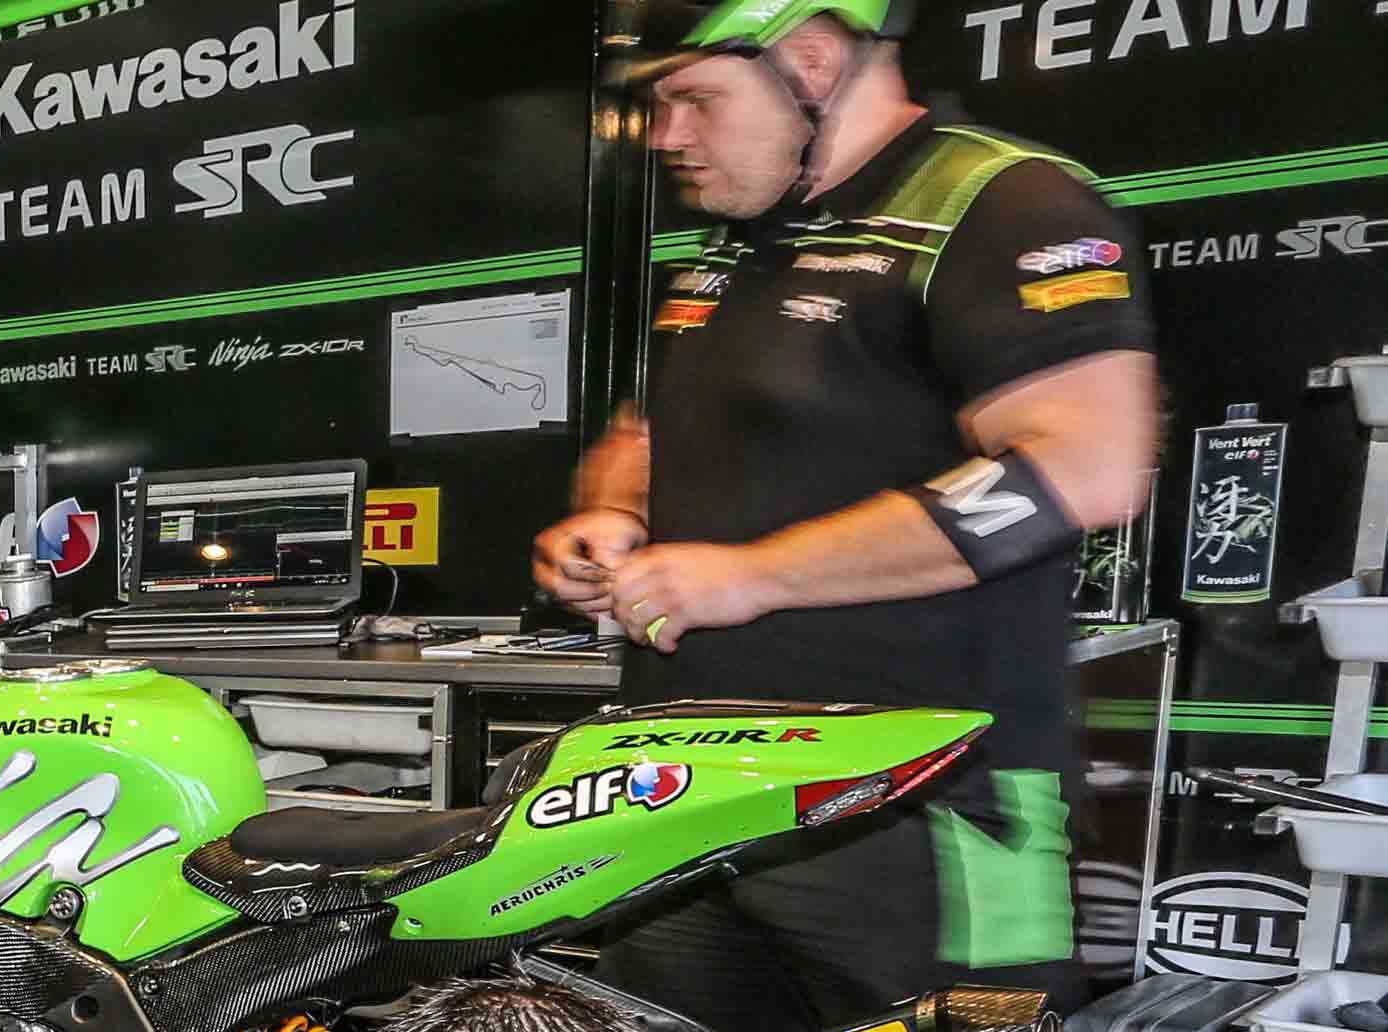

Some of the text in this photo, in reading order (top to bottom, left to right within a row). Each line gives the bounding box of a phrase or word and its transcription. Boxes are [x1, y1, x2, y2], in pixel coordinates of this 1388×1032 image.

[172, 124, 354, 219] SRC
[1149, 233, 1260, 270] TEAM
[87, 353, 139, 376] TEAM
[208, 335, 273, 372] Ninja
[1196, 573, 1261, 586] Kawasaki
[529, 771, 625, 826] elf
[490, 866, 586, 917] AEROCHRIS
